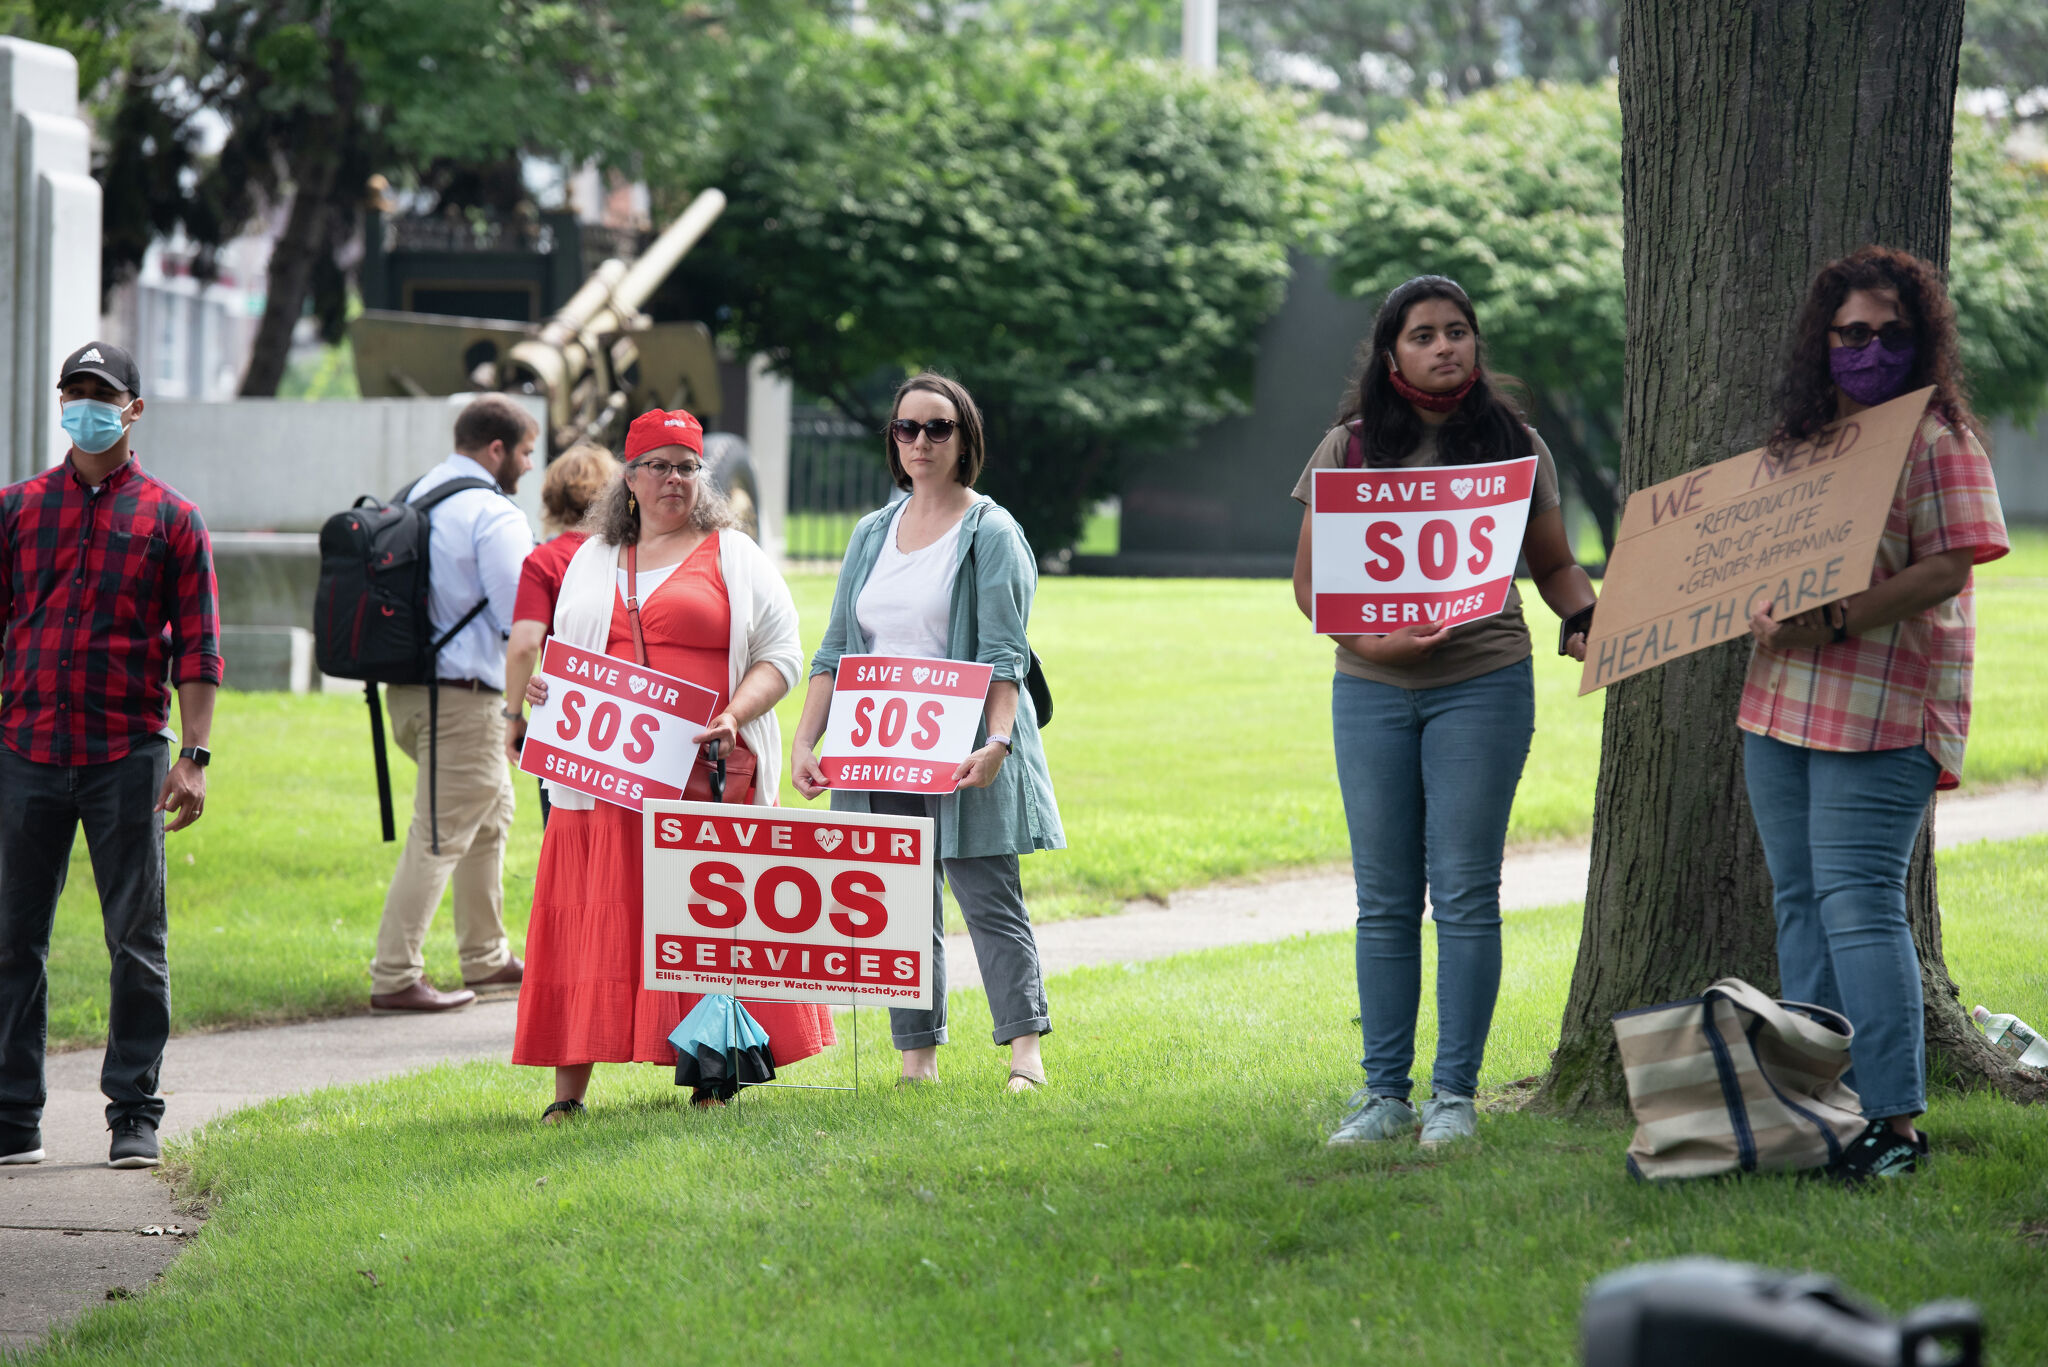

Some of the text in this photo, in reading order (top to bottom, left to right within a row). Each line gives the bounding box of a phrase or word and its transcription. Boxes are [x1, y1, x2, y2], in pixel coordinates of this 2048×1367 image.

[1356, 481, 1436, 503] SAVE
[1651, 468, 1712, 526] WE
[1699, 471, 1836, 538] REPRODUCTIVE
[1364, 514, 1496, 582] SOS
[1361, 592, 1486, 623] SERVICES
[565, 655, 620, 687] SAVE
[856, 665, 903, 682] SAVE
[556, 690, 661, 765] SOS
[850, 696, 945, 751] SOS
[544, 753, 644, 800] SERVICES
[839, 764, 933, 785] SERVICES
[660, 818, 793, 850] SAVE
[687, 860, 889, 939] SOS
[660, 941, 916, 981] SERVICES
[655, 971, 683, 981] Ellis
[693, 973, 734, 986] Trinity
[736, 976, 782, 990] Merger
[784, 980, 823, 991] Watch
[826, 984, 921, 999] www.schdy.org
